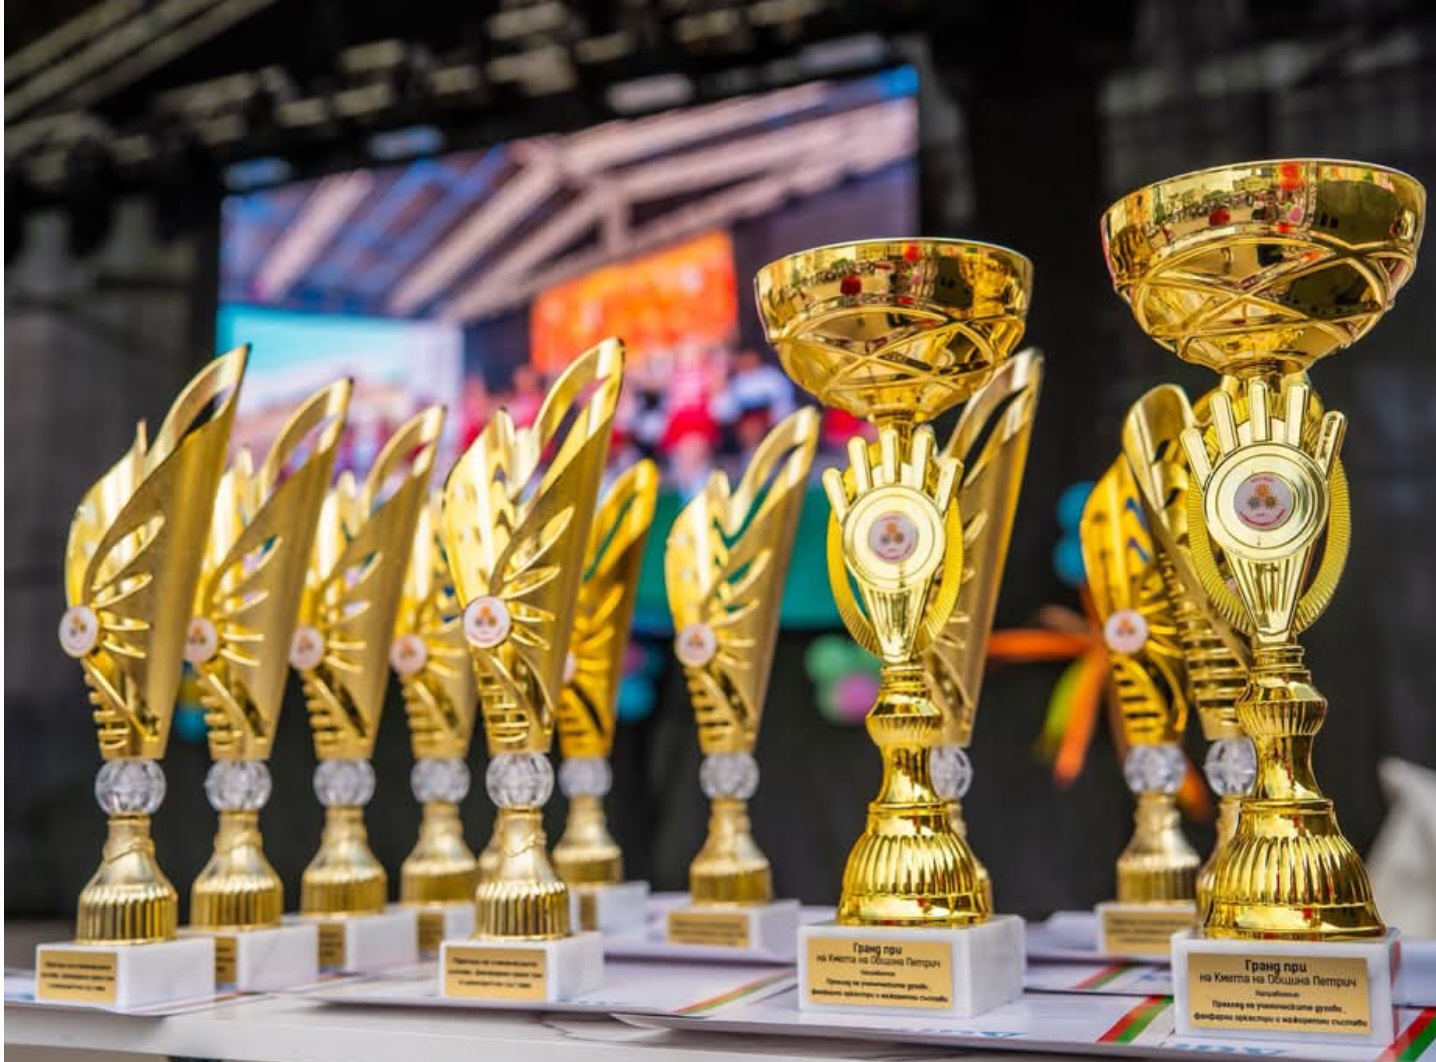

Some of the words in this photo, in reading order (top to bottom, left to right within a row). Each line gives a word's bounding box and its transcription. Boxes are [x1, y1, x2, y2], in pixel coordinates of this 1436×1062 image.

[853, 942, 881, 958] Гранд
[883, 944, 903, 956] при
[828, 954, 856, 964] Кмета
[858, 956, 869, 964] на
[906, 957, 941, 970] Петрич
[1244, 959, 1281, 978] Гранд
[1283, 960, 1307, 974] при
[1199, 974, 1212, 983] на
[1213, 972, 1250, 984] Кмета
[1252, 974, 1265, 984] на
[1267, 973, 1311, 986] Община
[1313, 975, 1357, 989] Петрич
